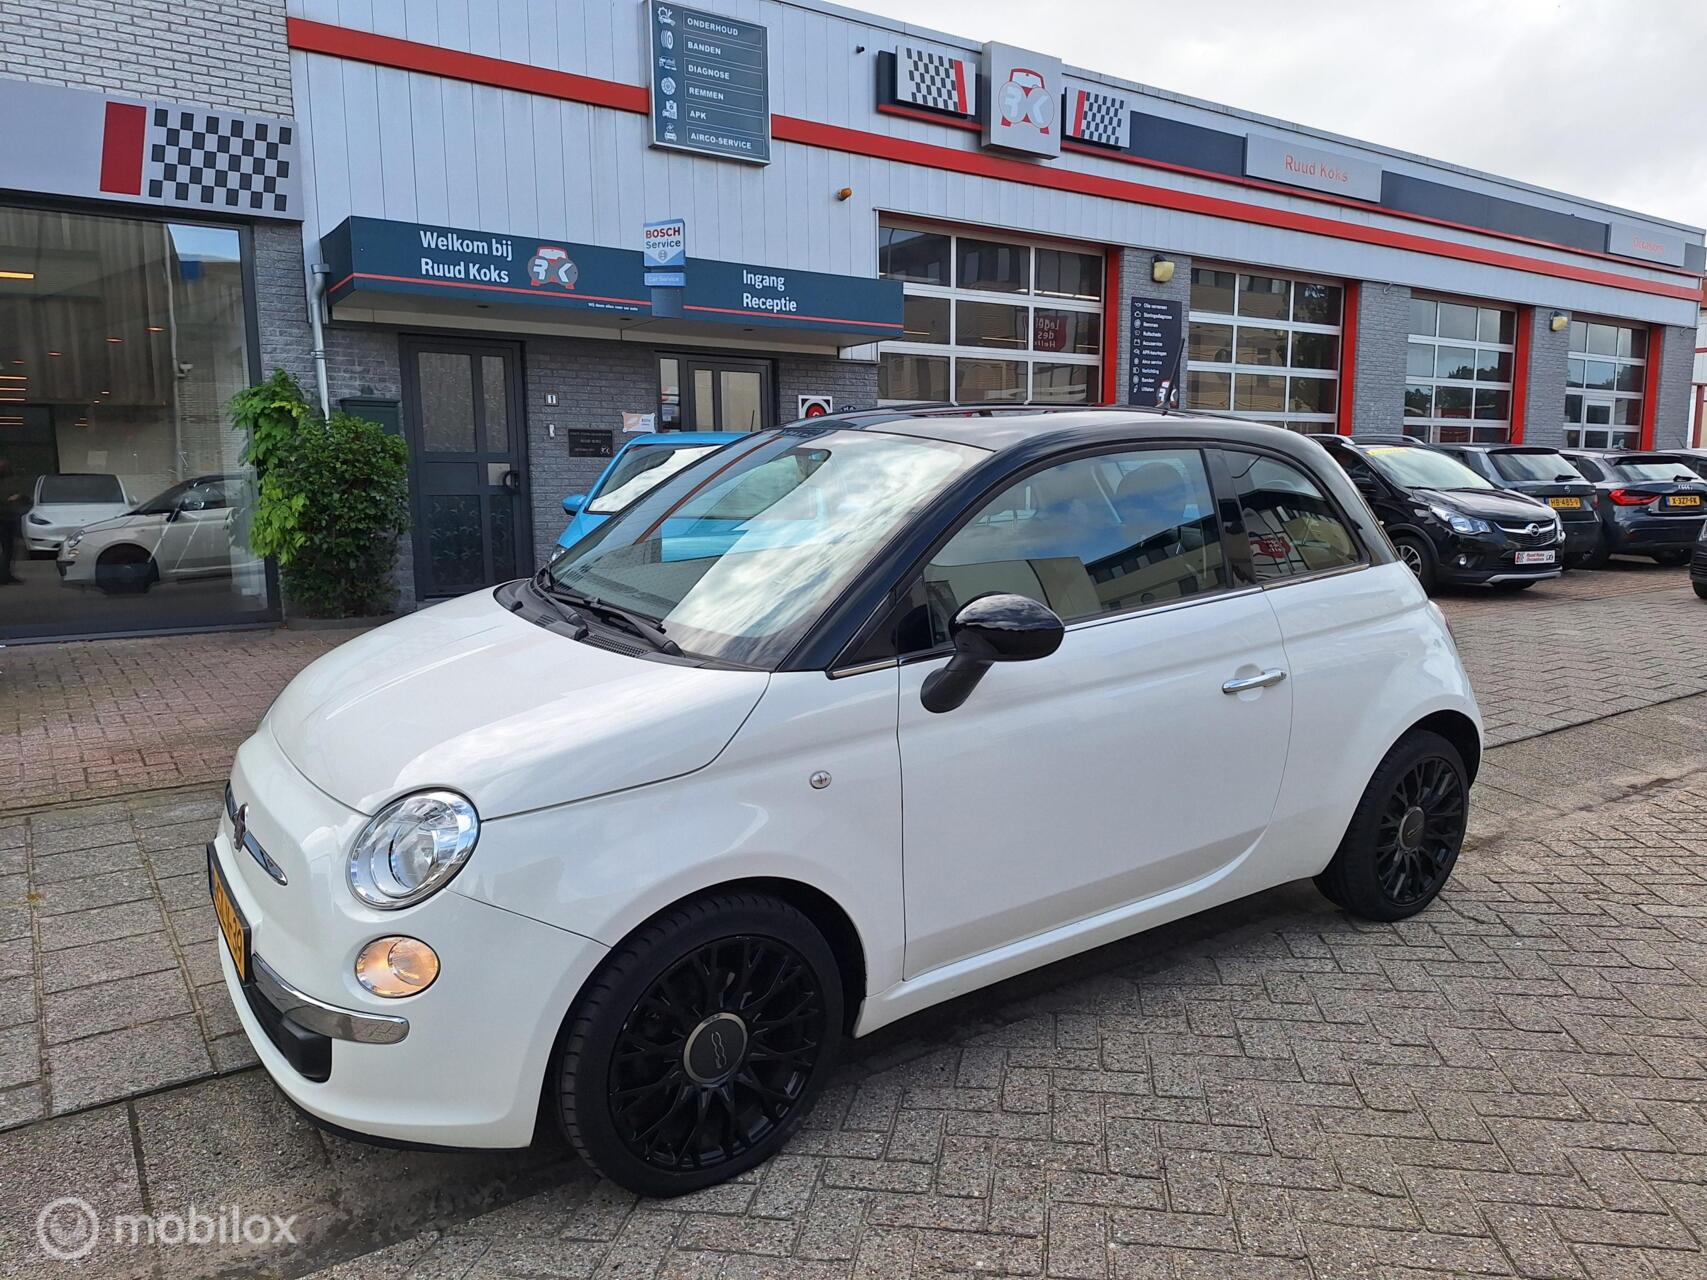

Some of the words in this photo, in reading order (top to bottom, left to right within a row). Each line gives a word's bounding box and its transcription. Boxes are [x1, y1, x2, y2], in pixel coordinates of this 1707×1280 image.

[687, 17, 739, 36] ONDERHOUD
[687, 41, 721, 55] BANDEN
[688, 64, 730, 80] DIAGNOSE
[689, 86, 724, 100] REMMEN
[690, 110, 707, 120] APK
[690, 132, 752, 150] AIRCO-SERVICE
[1285, 154, 1316, 176] Ruud
[1320, 163, 1349, 182] Koks
[645, 226, 681, 239] BOSCH
[419, 230, 489, 255] Welkom
[492, 238, 513, 261] bij
[645, 239, 681, 249] Service
[420, 257, 465, 279] Ruud
[469, 262, 510, 283] Koks
[742, 269, 786, 292] Ingang
[742, 292, 798, 313] Receptie
